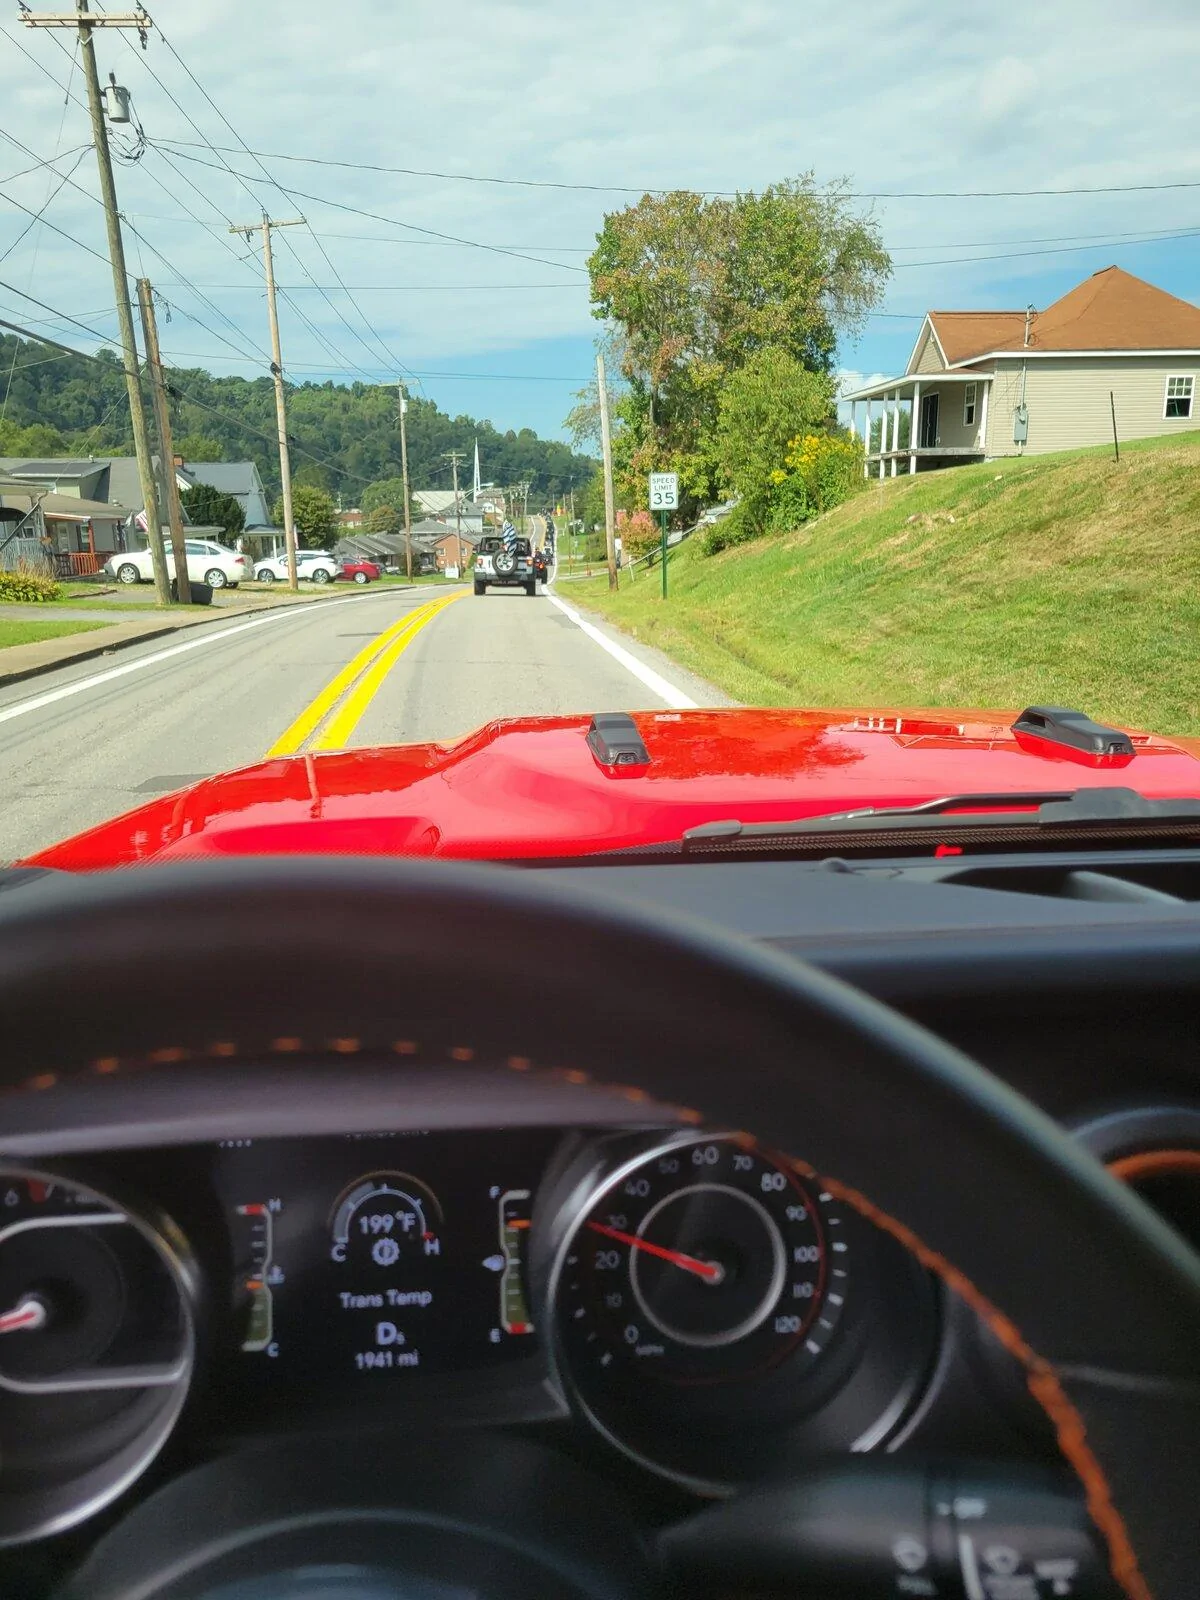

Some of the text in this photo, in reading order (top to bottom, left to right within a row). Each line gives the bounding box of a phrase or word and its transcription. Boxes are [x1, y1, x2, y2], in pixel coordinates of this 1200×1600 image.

[653, 492, 675, 505] 35
[691, 1146, 720, 1166] 60
[733, 1154, 755, 1171] 70
[761, 1172, 787, 1192] 80
[331, 1243, 347, 1262] C
[423, 1238, 440, 1256] H
[595, 1250, 620, 1269] 20
[339, 1289, 433, 1309] Trans Temp
[624, 1324, 639, 1344] 0
[355, 1349, 419, 1370] 1941 mi
